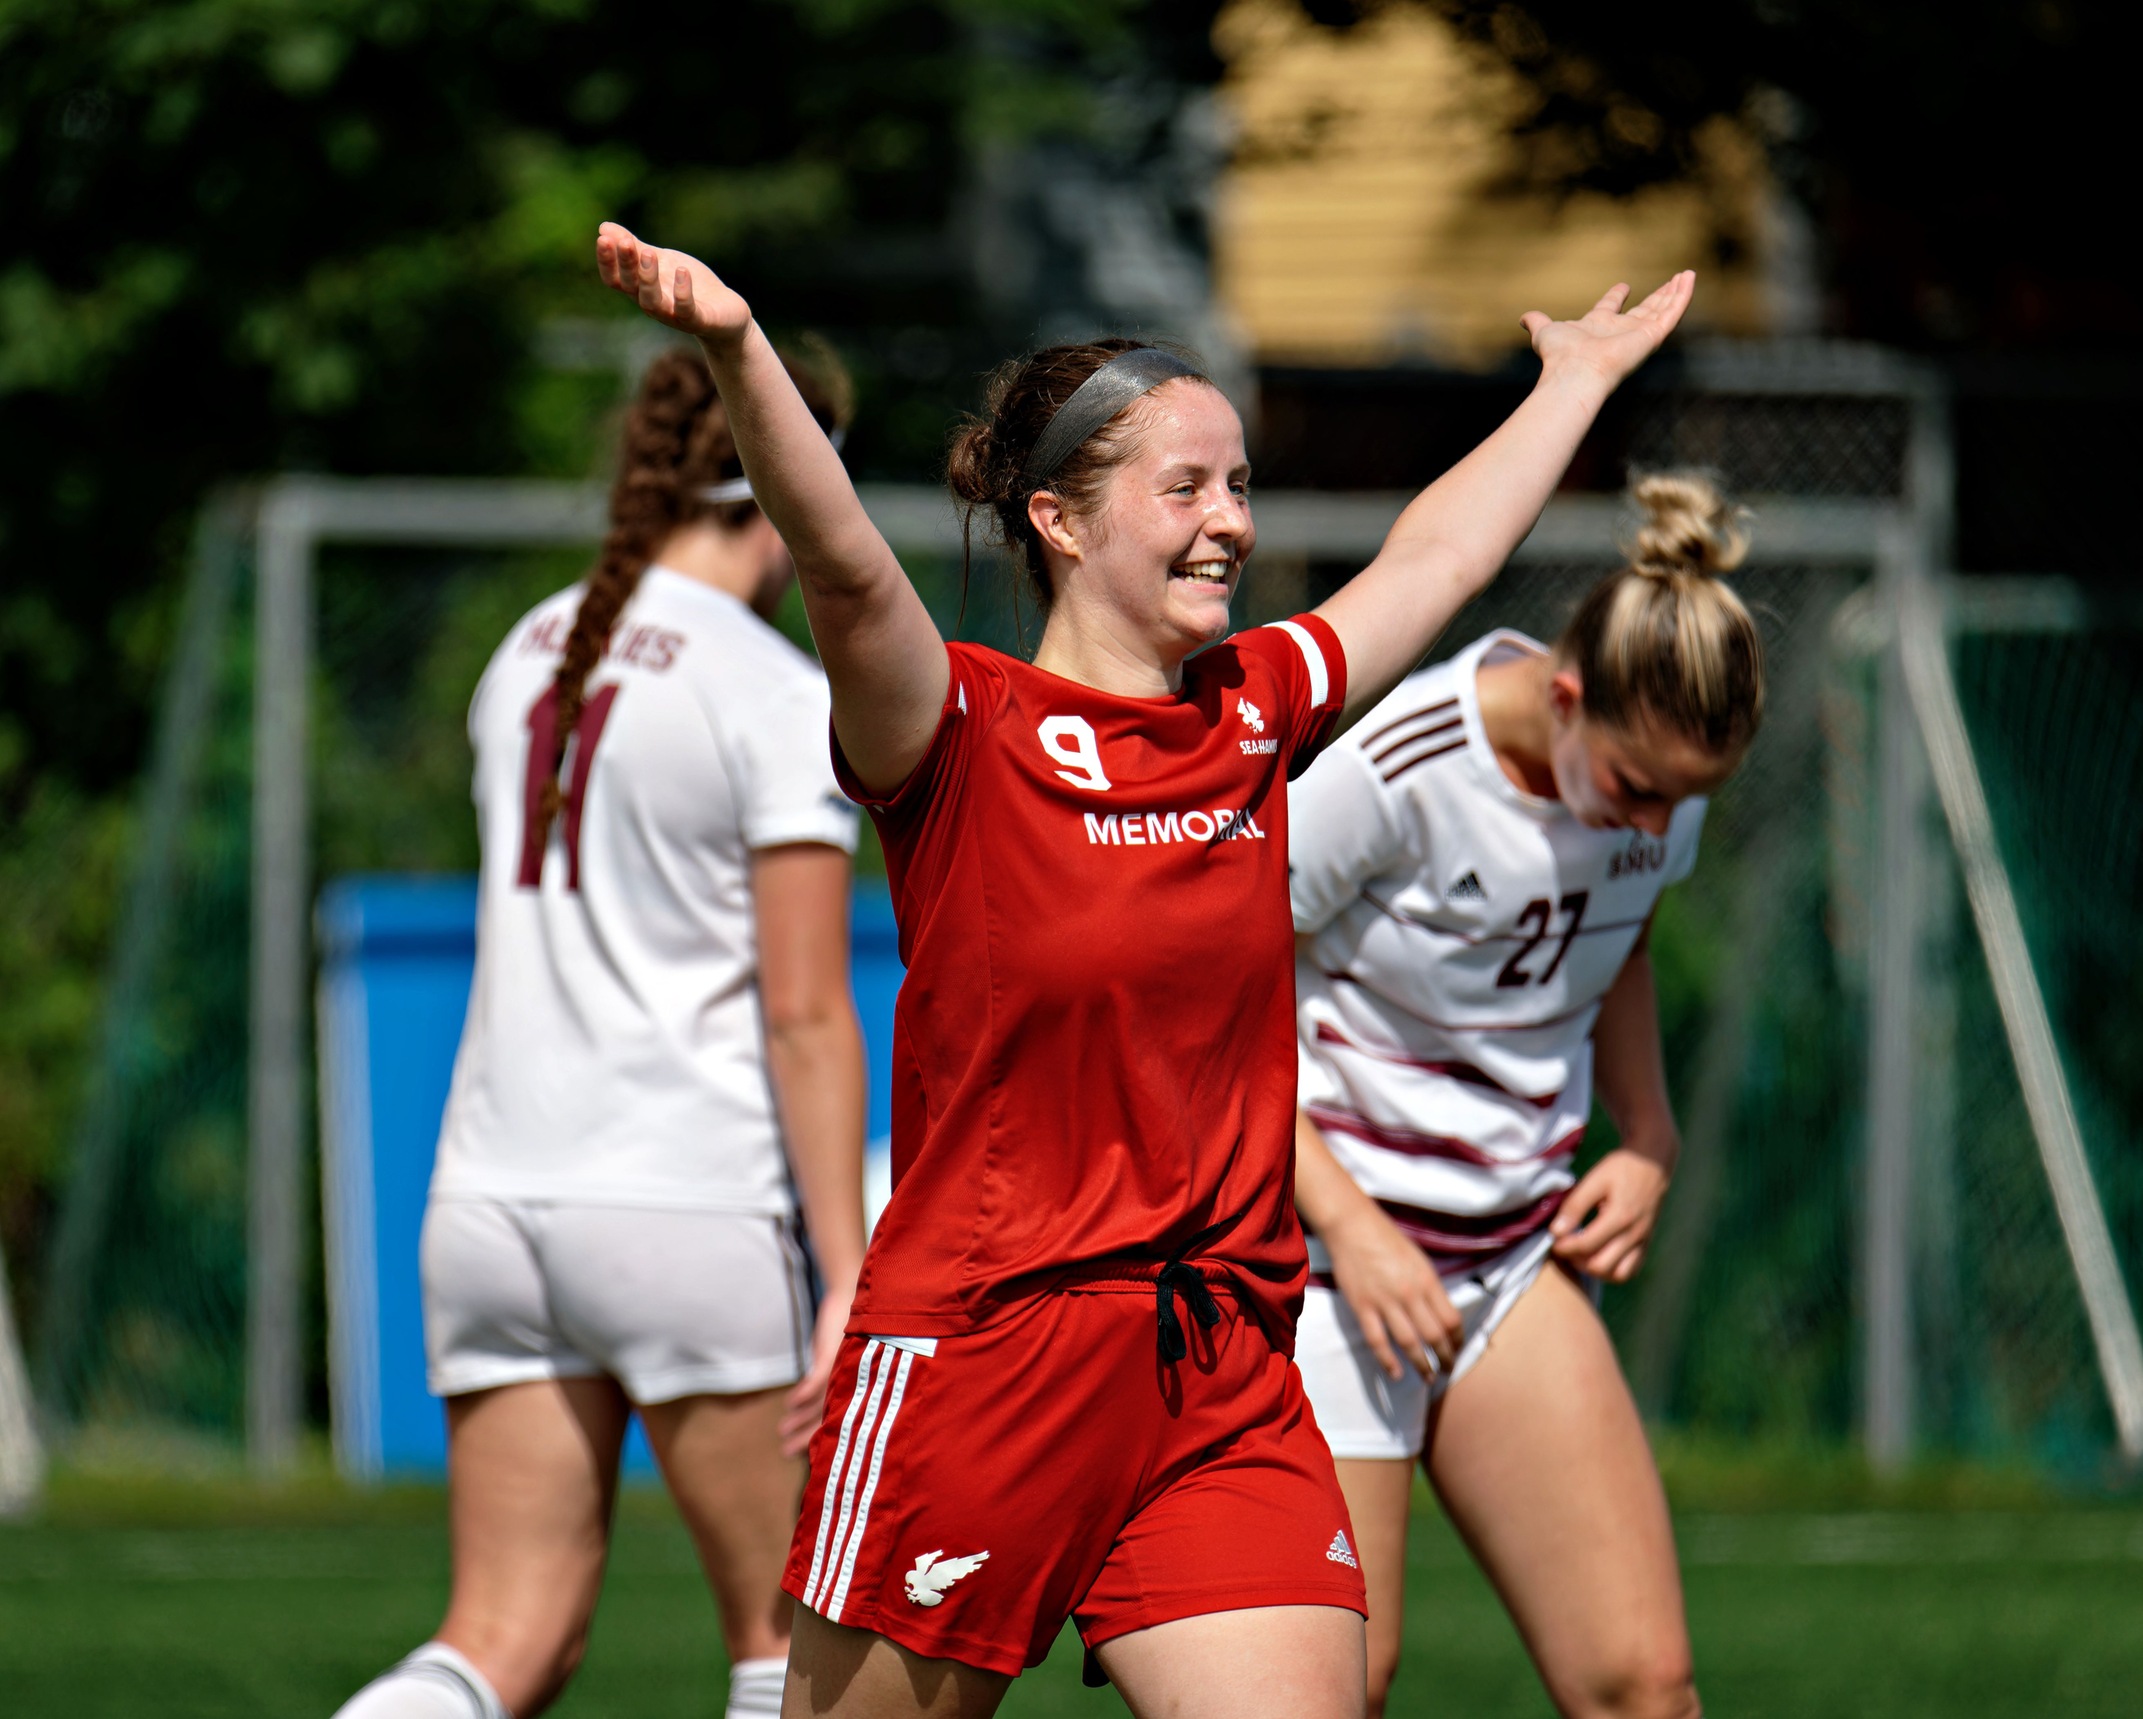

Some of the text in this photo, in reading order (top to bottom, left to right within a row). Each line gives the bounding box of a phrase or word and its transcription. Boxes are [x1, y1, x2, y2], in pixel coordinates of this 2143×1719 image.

[516, 682, 620, 890] 11
[1037, 715, 1112, 791] 9
[1496, 890, 1589, 988] 27
